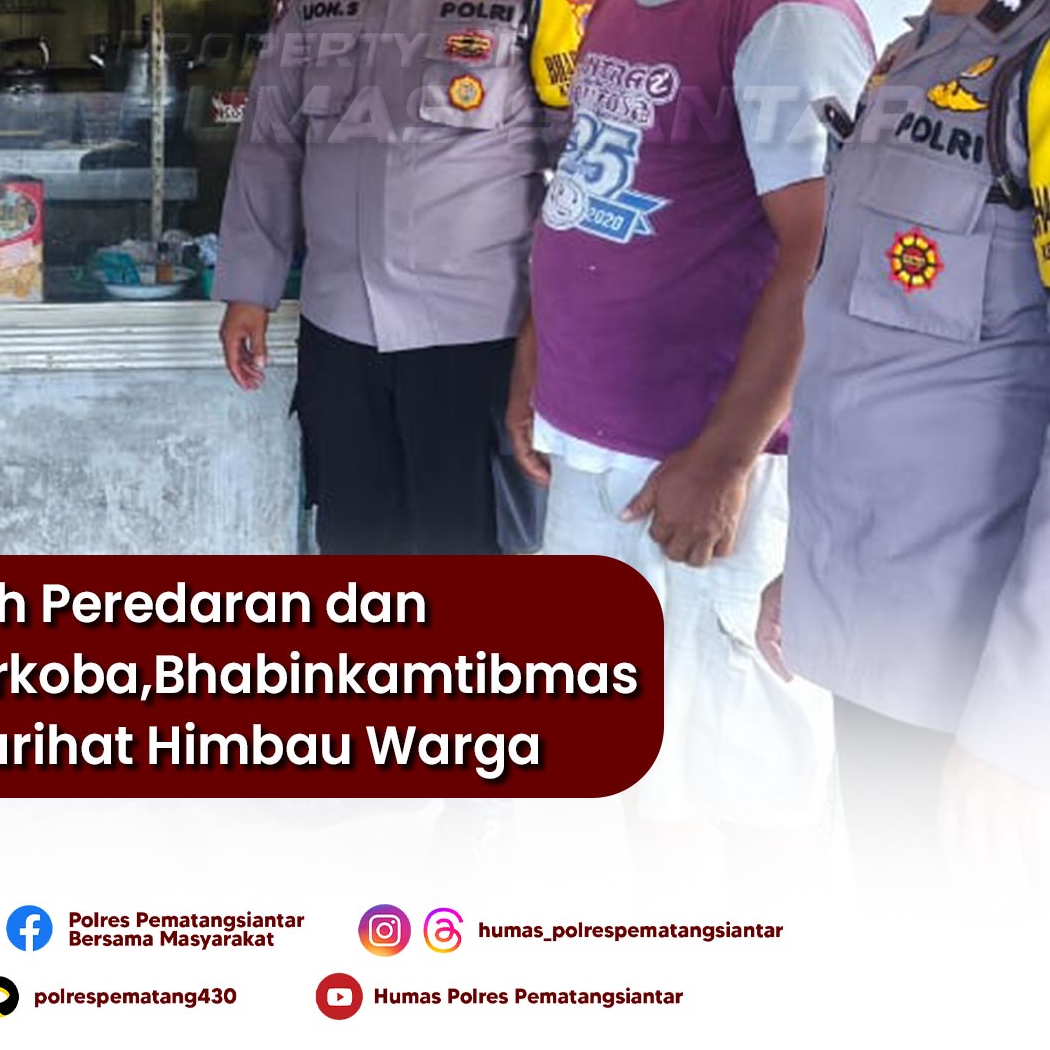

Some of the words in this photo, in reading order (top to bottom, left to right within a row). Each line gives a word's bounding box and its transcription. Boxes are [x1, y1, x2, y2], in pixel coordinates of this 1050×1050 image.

[440, 1, 514, 23] POLRI
[894, 111, 985, 165] POLRI
[588, 205, 624, 231] 2020
